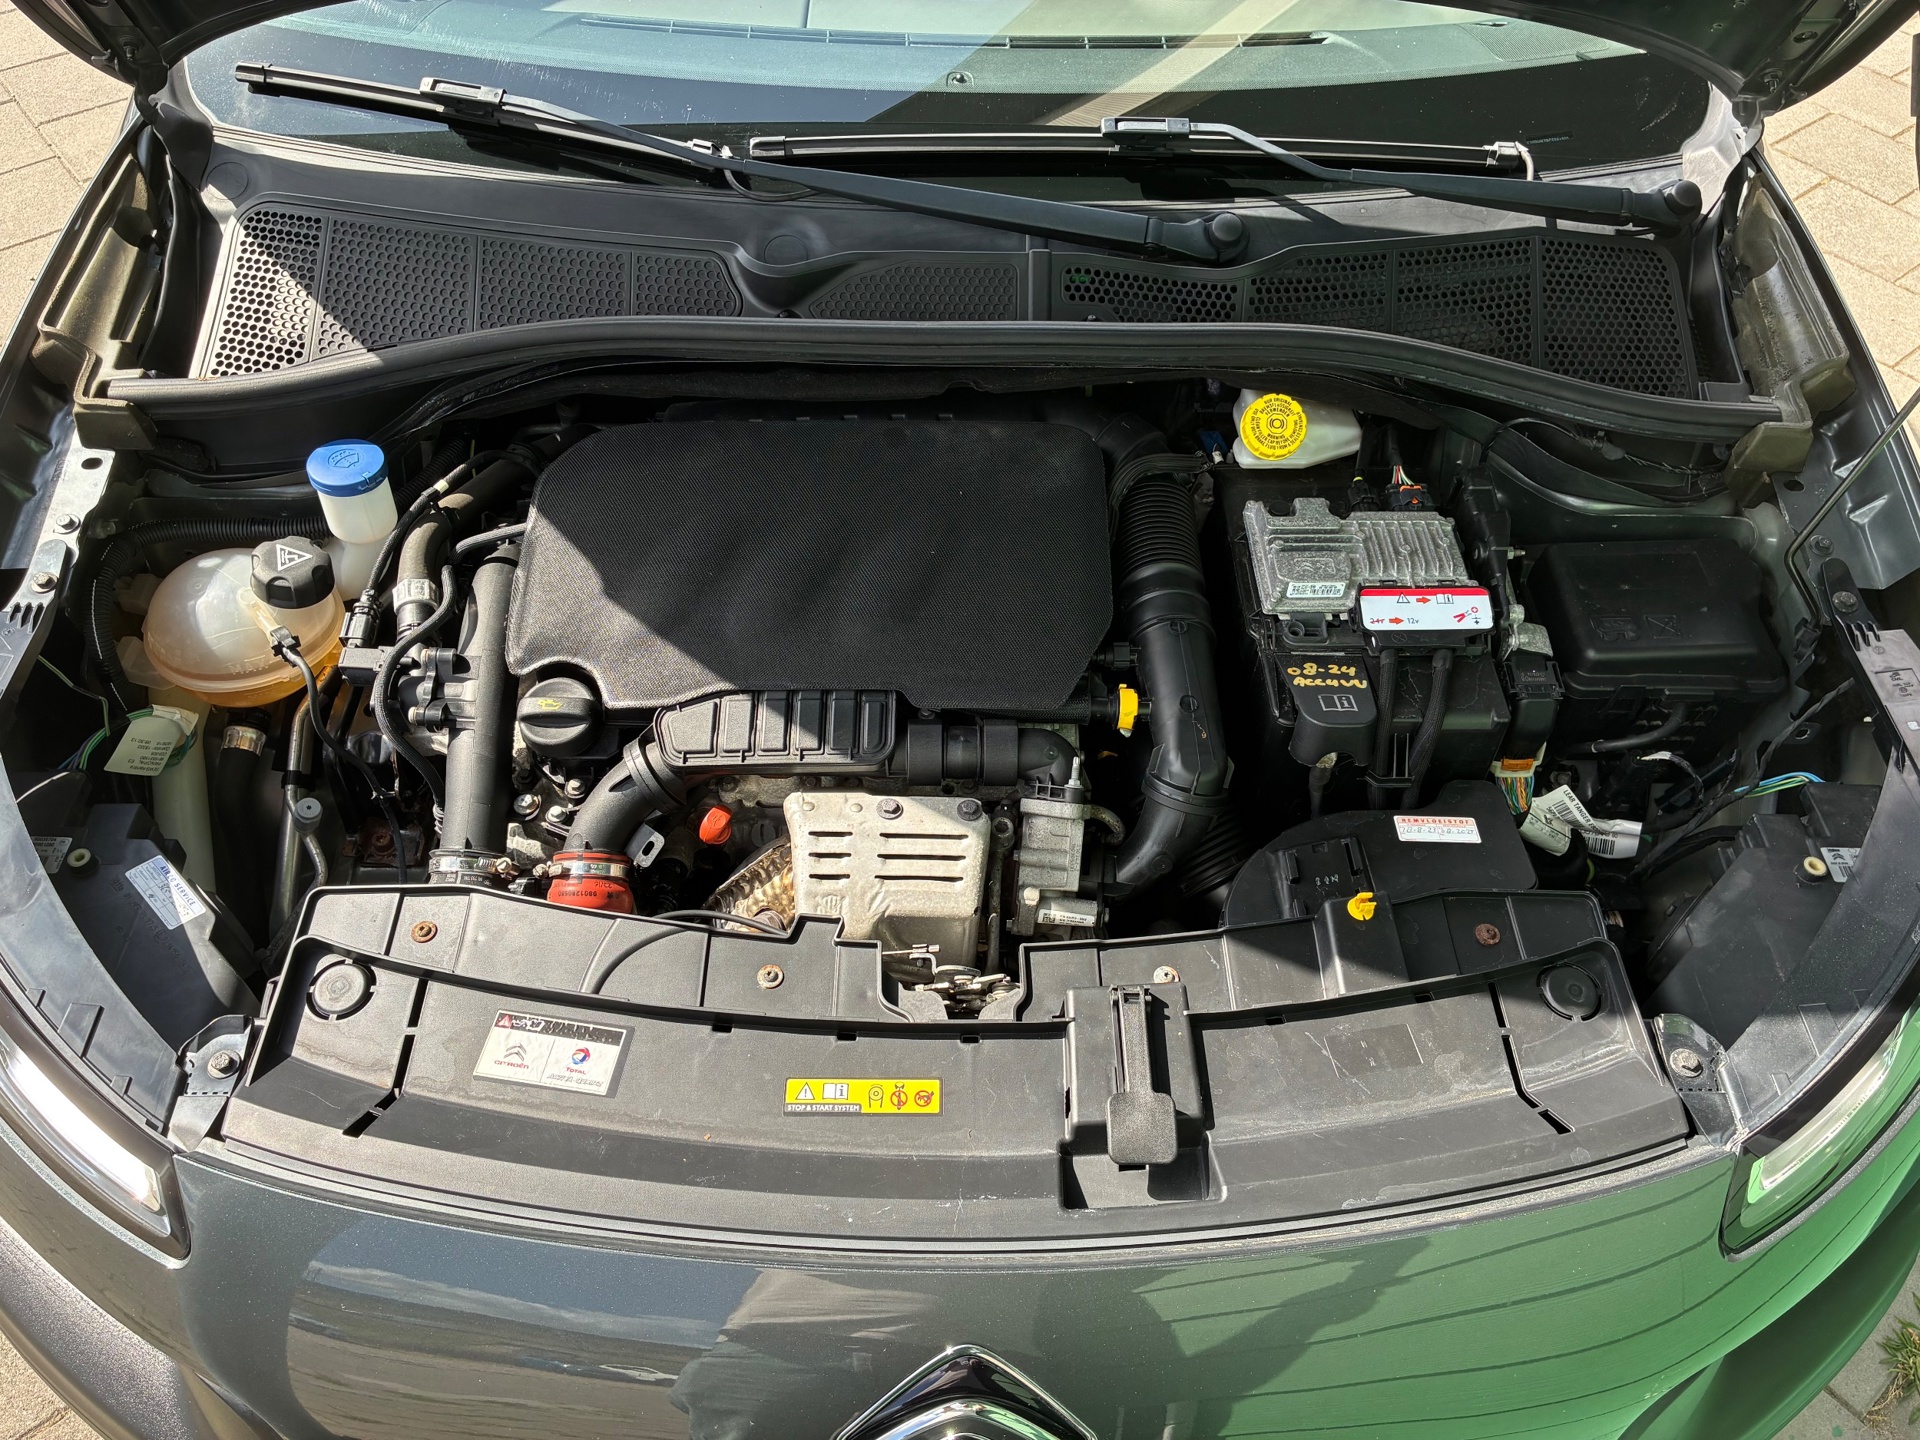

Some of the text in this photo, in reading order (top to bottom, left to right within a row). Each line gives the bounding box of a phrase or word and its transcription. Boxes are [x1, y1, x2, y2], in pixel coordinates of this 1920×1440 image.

[1287, 662, 1356, 676] 08-24
[1563, 789, 1576, 803] LEAR
[1574, 803, 1590, 824] TANGER
[174, 882, 196, 906] SERVICE
[566, 1066, 586, 1075] TOTAL
